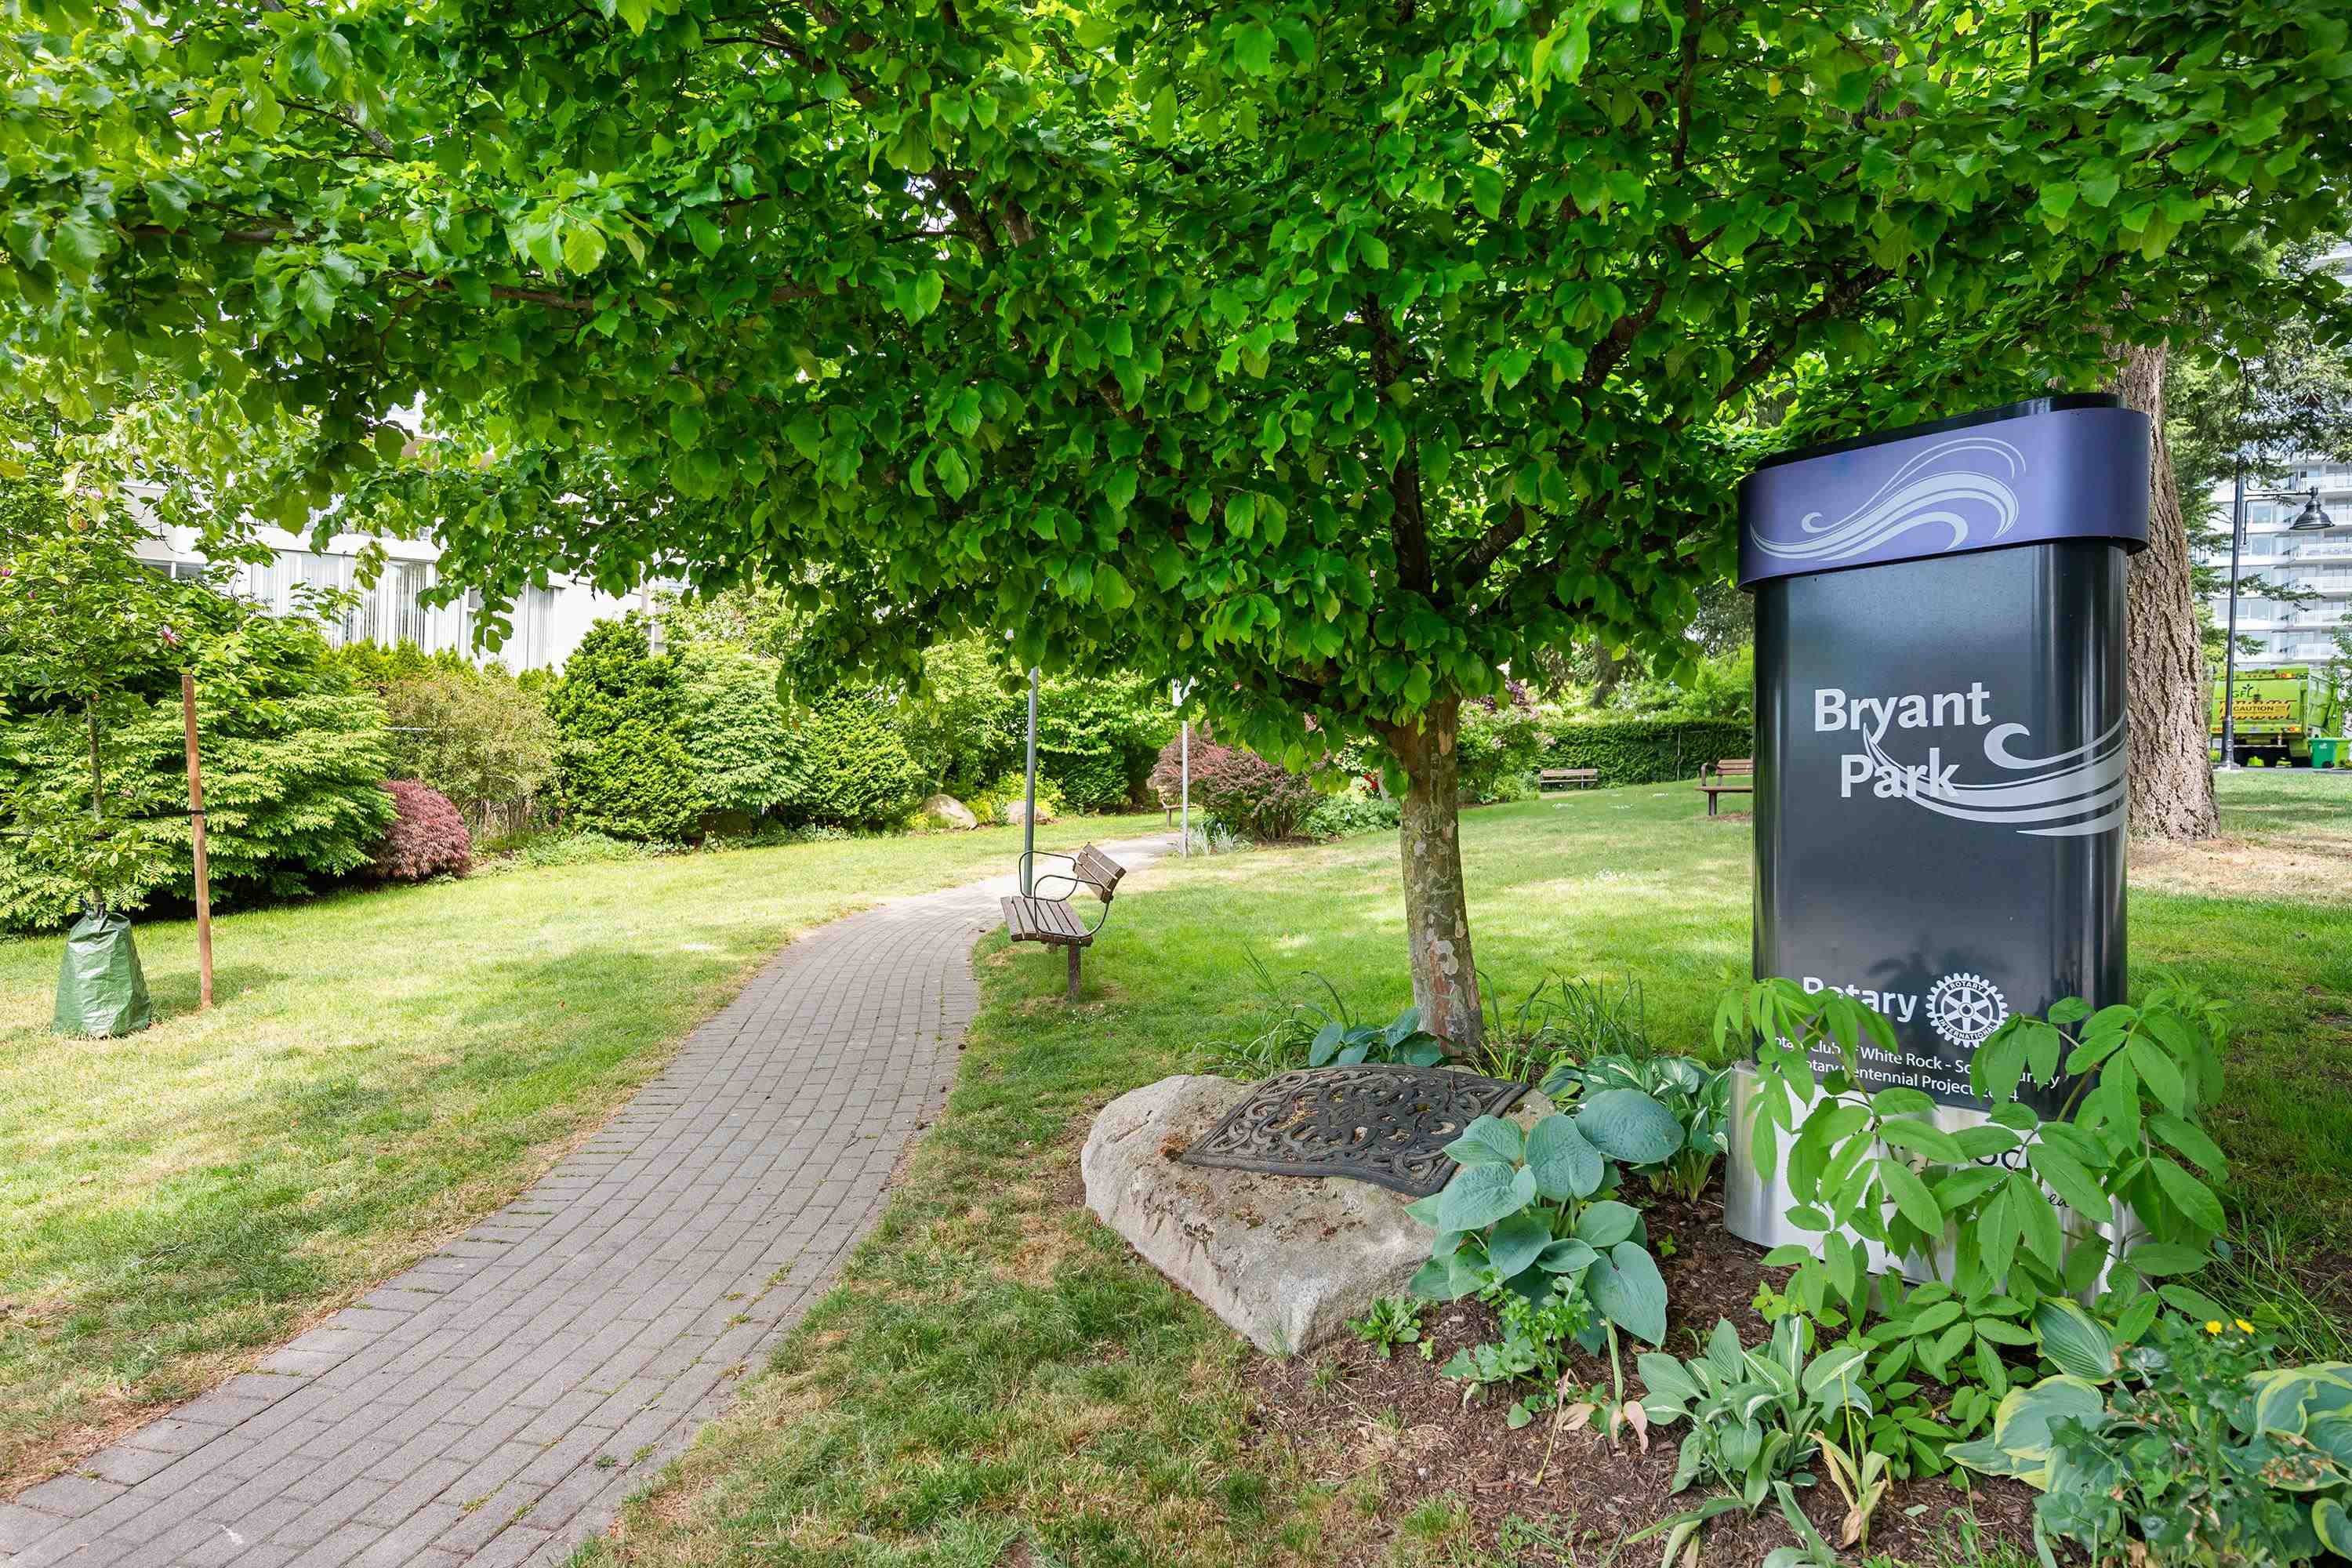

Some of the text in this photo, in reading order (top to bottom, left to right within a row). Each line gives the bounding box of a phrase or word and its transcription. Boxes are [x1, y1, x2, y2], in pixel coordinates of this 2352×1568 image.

[2233, 688, 2252, 698] GFL
[1814, 682, 1991, 744] Bryant
[1841, 747, 1962, 797] Park
[1950, 980, 1984, 992] ROTARY
[1938, 1018, 1997, 1040] INTERNATIONAL
[1860, 1046, 1902, 1064] White
[1906, 1053, 1943, 1070] Rock
